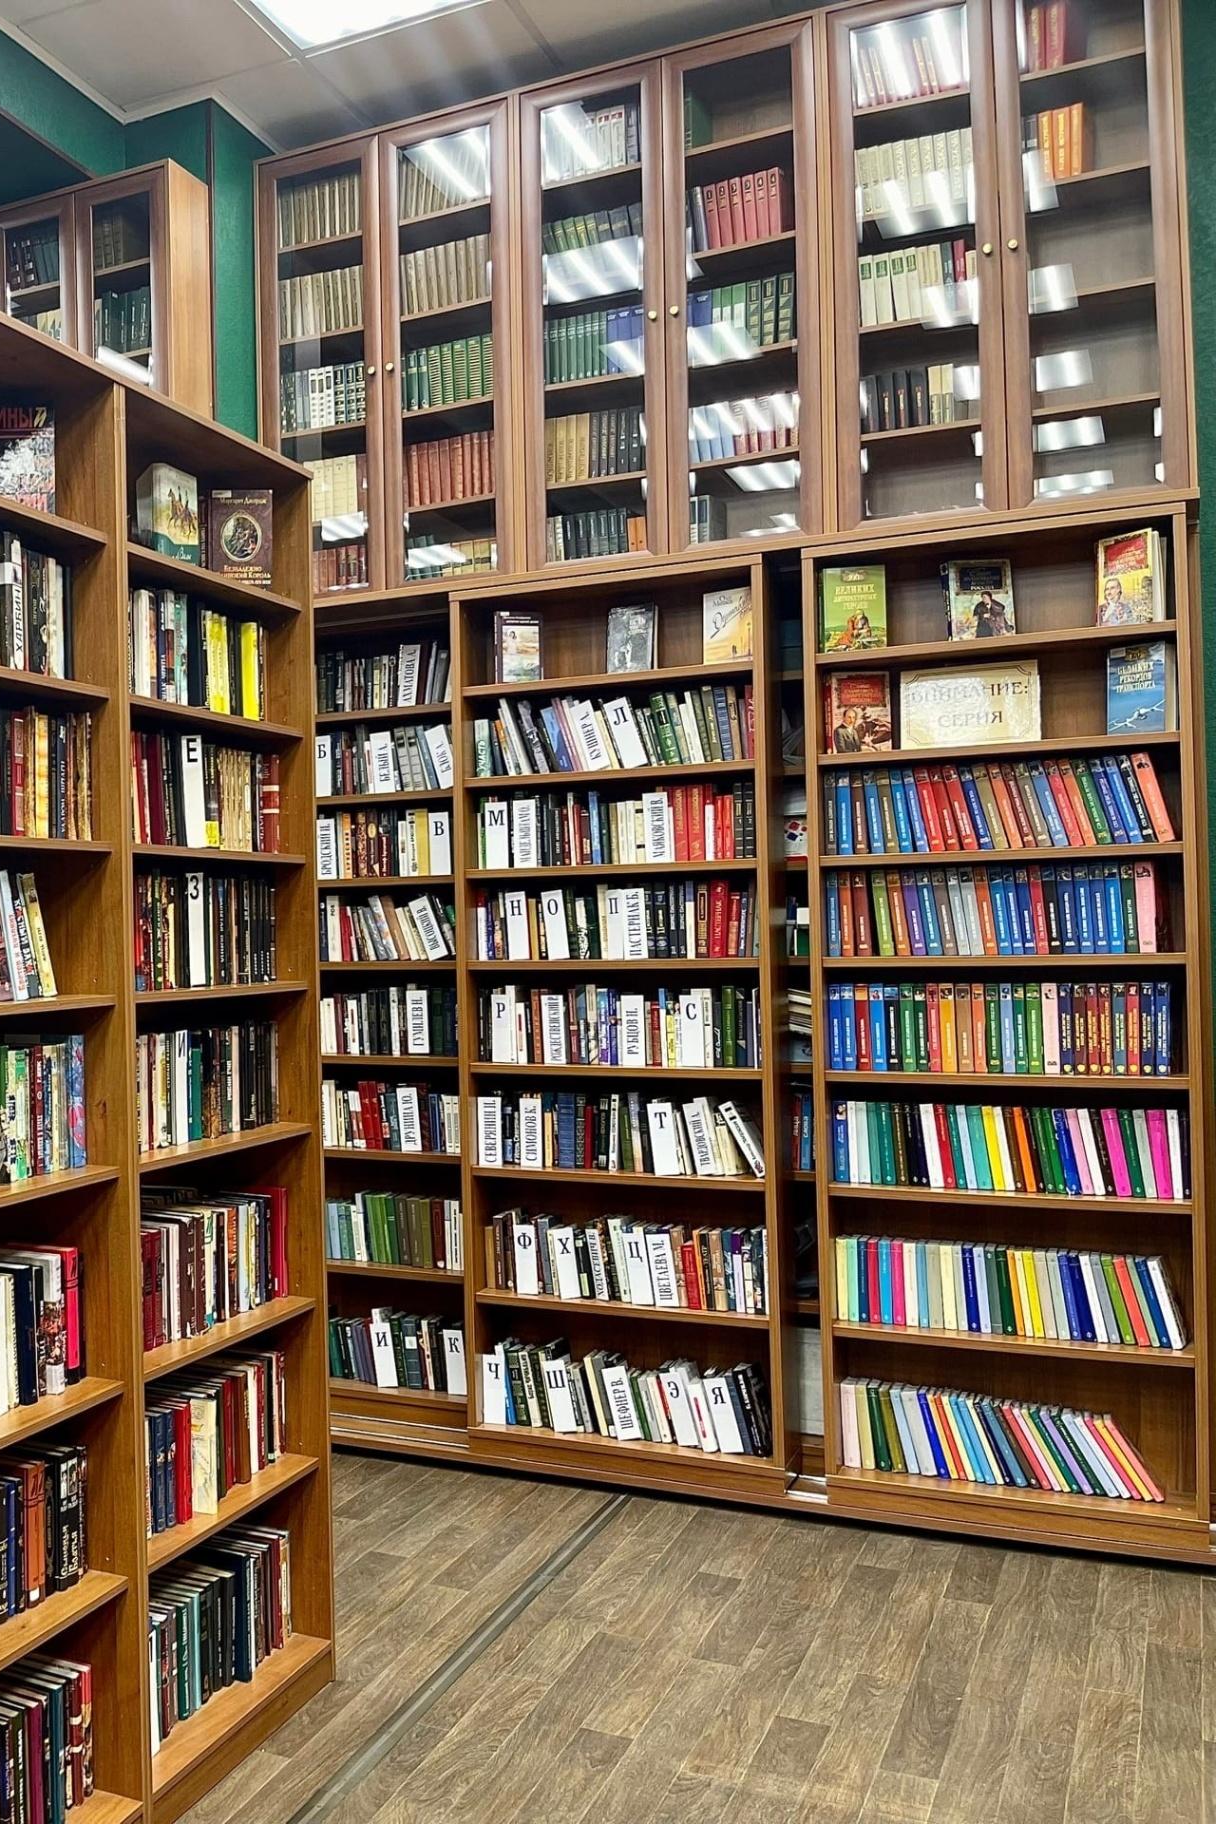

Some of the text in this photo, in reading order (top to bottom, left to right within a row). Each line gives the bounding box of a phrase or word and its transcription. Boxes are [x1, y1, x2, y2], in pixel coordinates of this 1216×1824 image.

[835, 584, 875, 594] ВЕЛИКИХ
[13, 586, 24, 652] ХАРБИН
[402, 660, 416, 703] АХМАТОВА
[909, 681, 1028, 704] ВНИМАНИЕ:
[613, 709, 629, 726] Л
[938, 711, 1003, 728] СЕРИЯ
[186, 738, 198, 763] Е
[317, 744, 327, 758] Б
[582, 722, 602, 761] КУШНЕР
[379, 754, 391, 783] БЕЛЫЙ
[436, 751, 451, 773] БЛОК
[477, 739, 490, 776] УЧАСТЬ
[434, 821, 444, 836] В
[488, 810, 505, 826] М
[520, 813, 532, 864] МАНДЕЛЬШТАМ
[653, 808, 666, 859] МАЯКОВСКИЙ
[320, 833, 332, 875] БРОДСКИЙ
[510, 900, 522, 916] Н
[547, 899, 559, 915] О
[608, 898, 619, 914] П
[418, 913, 440, 950] ВЫСОЦКИЙ
[626, 902, 644, 957] ПАСТЕРНАК
[495, 1003, 506, 1018] Р
[686, 1003, 697, 1020] С
[413, 1006, 424, 1047] ГУМИЛЕВ
[551, 1004, 562, 1062] РОЖДЕСТВЕНСКИЙ
[627, 1018, 639, 1055] РУБЦОВ
[178, 1033, 186, 1057] И
[403, 1103, 417, 1145] ДРУНИНА
[654, 1112, 667, 1129] Т
[485, 1110, 496, 1163] СЕВЕРЯНИН
[525, 1116, 537, 1161] СИМОНОВ
[690, 1120, 710, 1168] ТВАРДОВСКИЙ
[517, 1233, 532, 1249] Ф
[558, 1237, 571, 1254] Х
[629, 1241, 643, 1261] Ц
[589, 1241, 605, 1296] ХОДАСЕВИЧ
[656, 1254, 673, 1300] ЦВЕТАЕВА
[375, 1332, 389, 1347] И
[448, 1337, 461, 1353] К
[488, 1363, 500, 1380] Ч
[546, 1370, 566, 1389] Ш
[668, 1382, 680, 1399] Э
[712, 1388, 726, 1405] Я
[615, 1388, 634, 1430] ШЕФНЕР
